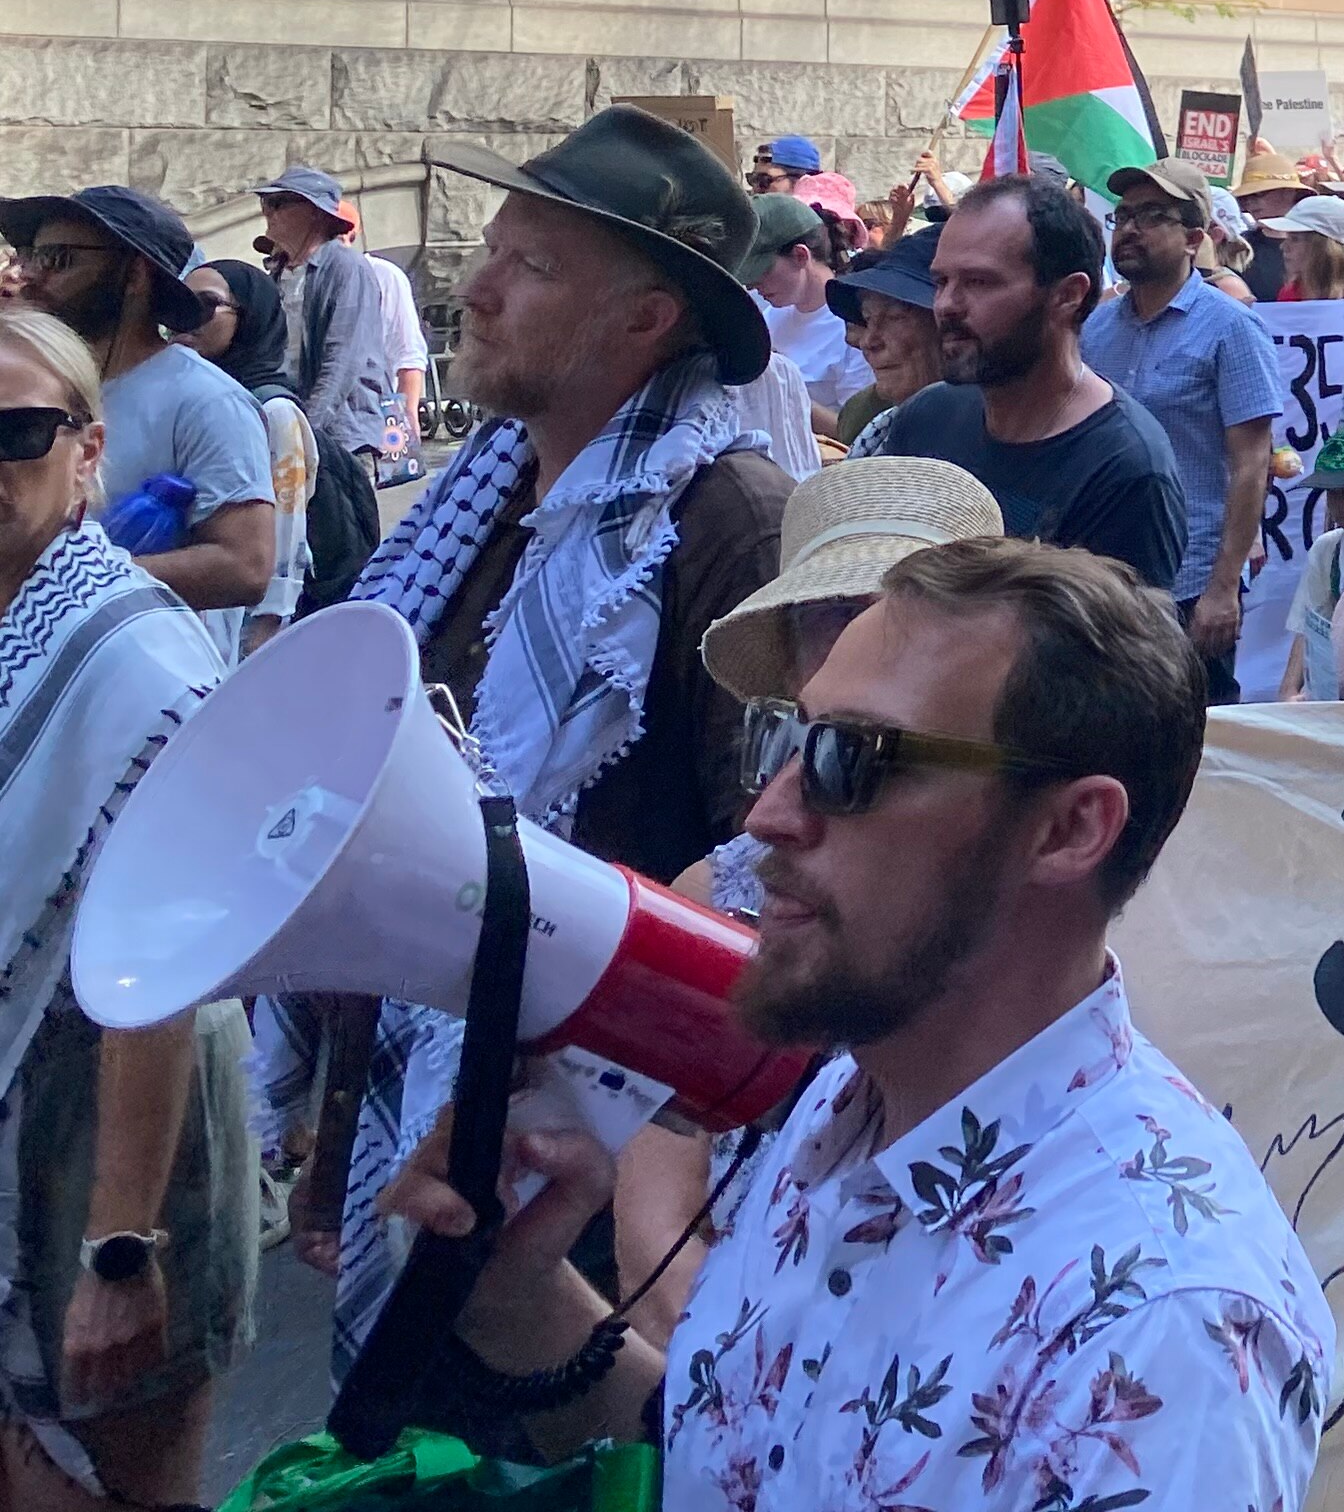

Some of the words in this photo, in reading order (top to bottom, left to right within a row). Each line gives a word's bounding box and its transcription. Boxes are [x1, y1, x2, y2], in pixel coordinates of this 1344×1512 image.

[1276, 99, 1324, 110] Palestine
[1184, 110, 1231, 138] END
[1181, 151, 1228, 164] BLOCKADE
[1196, 163, 1227, 176] GAZA
